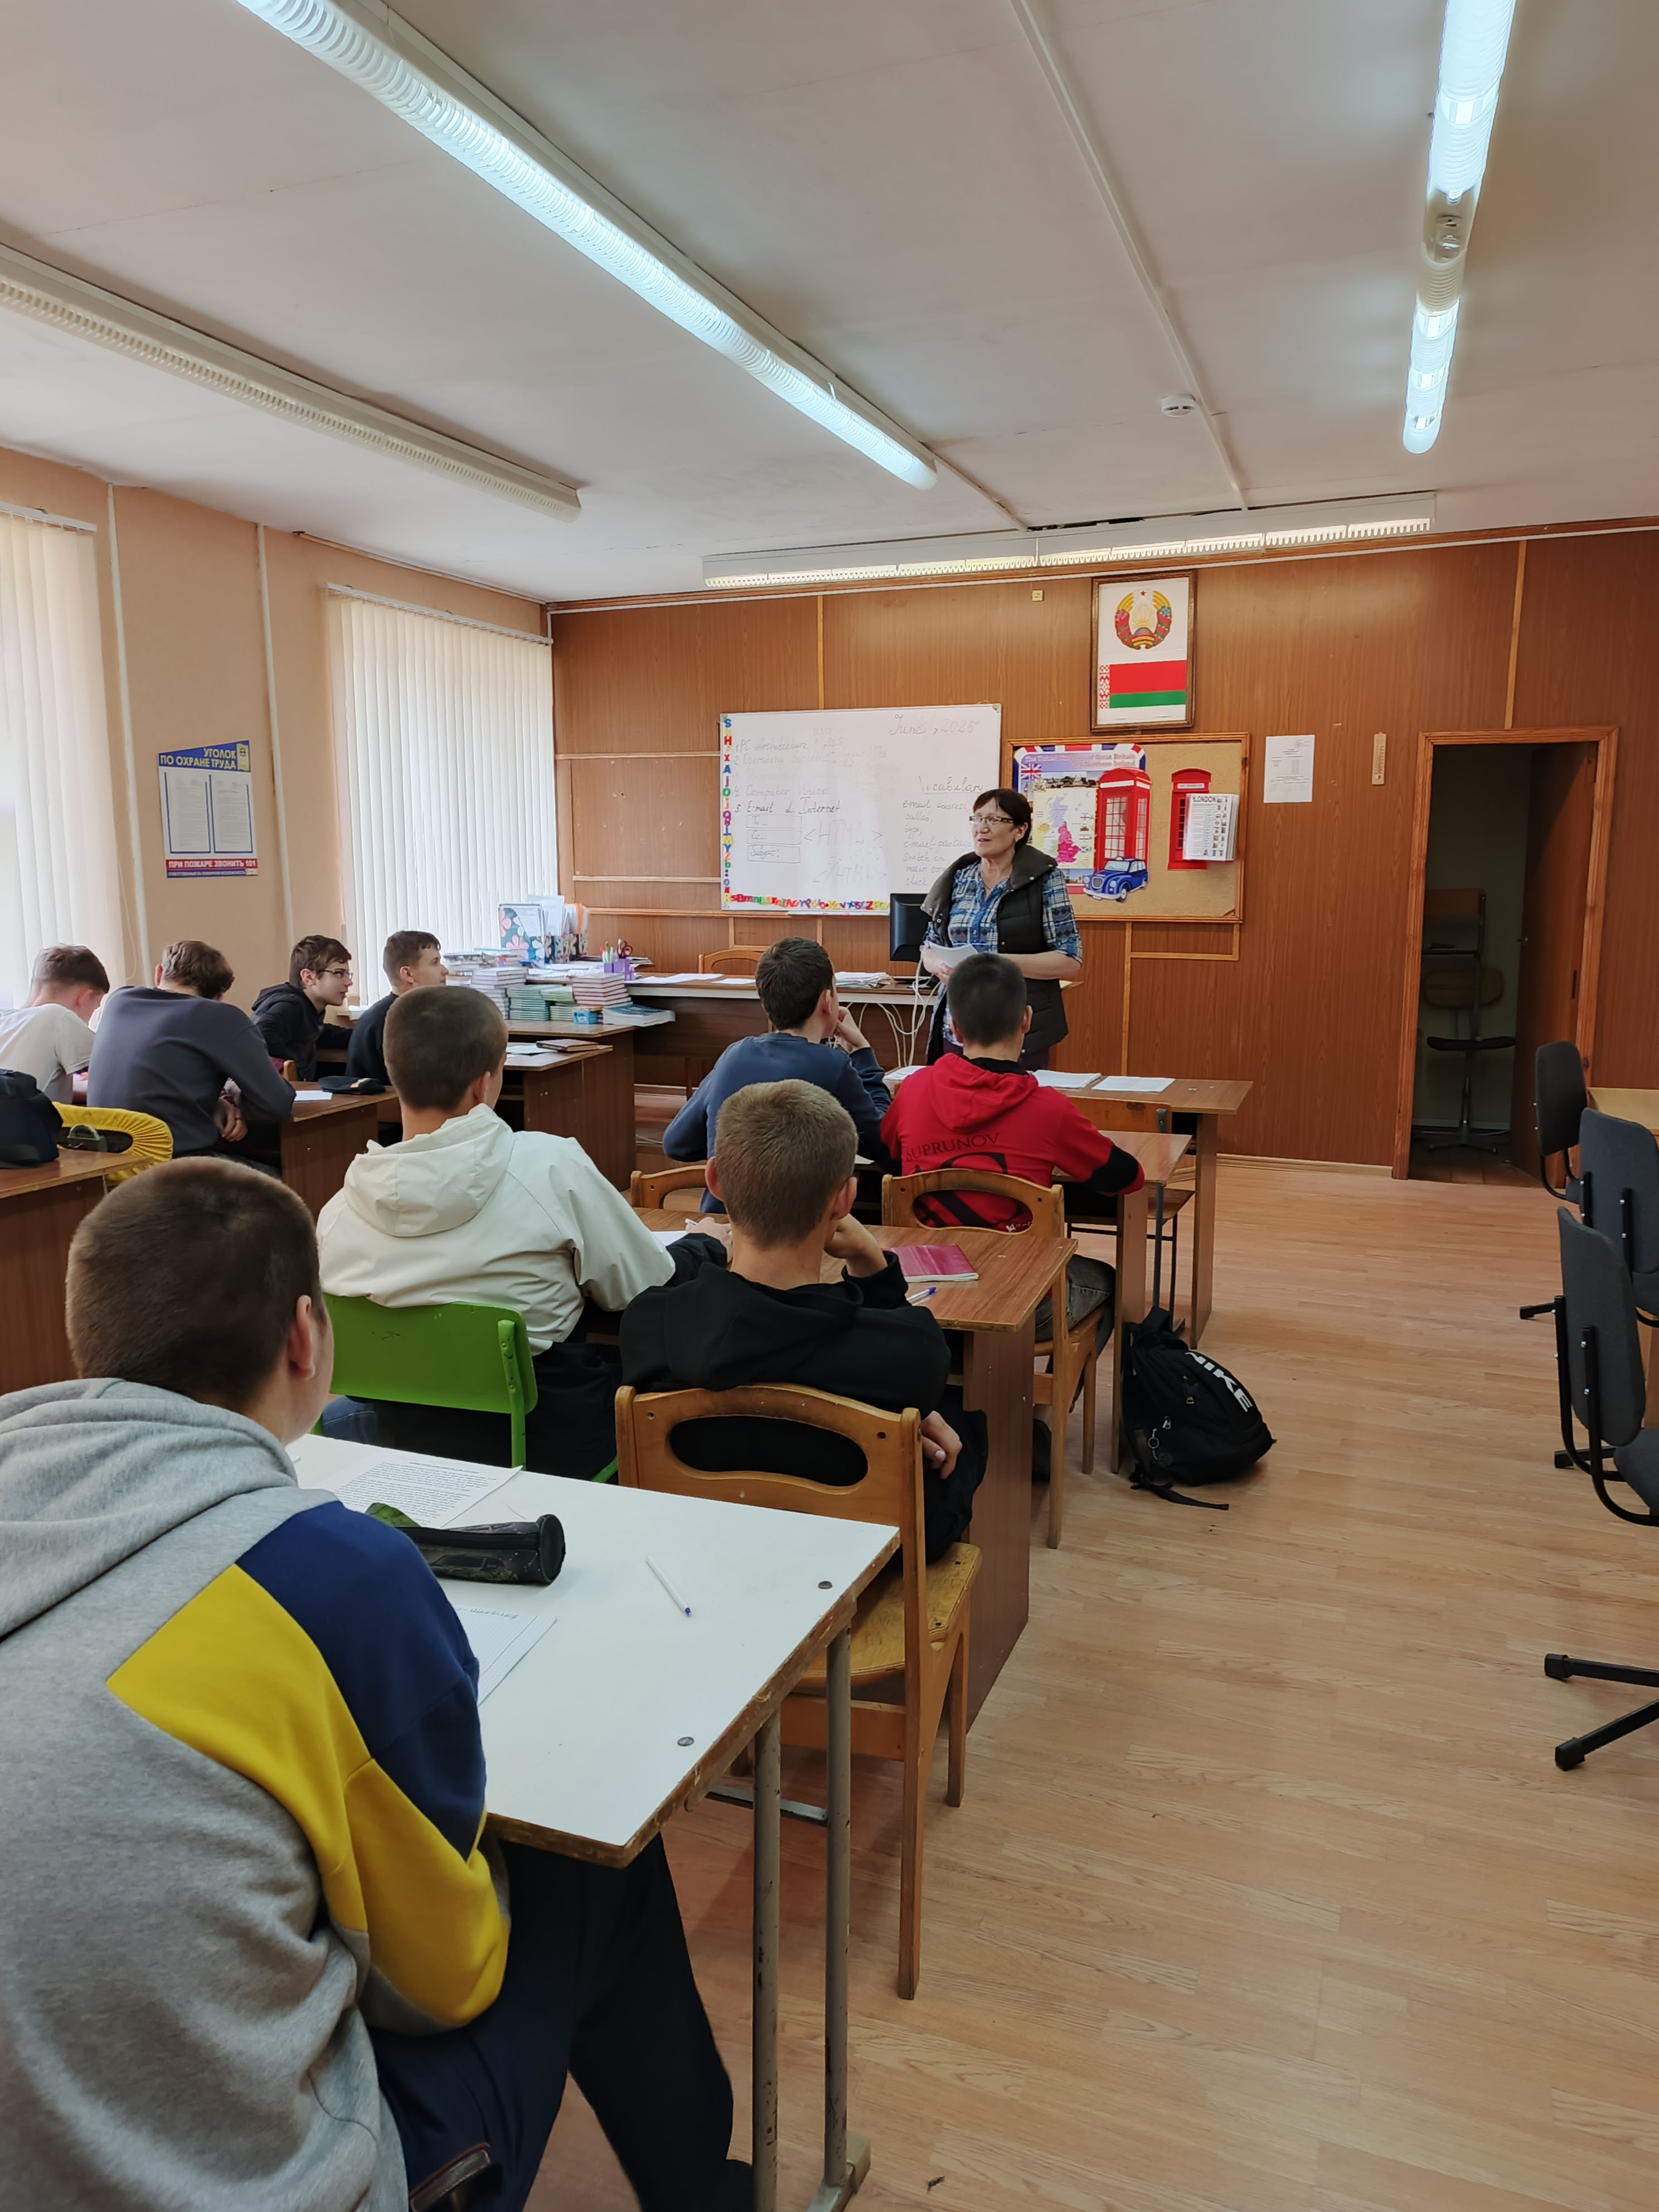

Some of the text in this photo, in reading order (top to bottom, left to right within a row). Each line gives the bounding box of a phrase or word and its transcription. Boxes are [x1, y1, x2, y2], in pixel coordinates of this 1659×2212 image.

[160, 755, 236, 769] ПО ОХРАНЕ ТРУДА
[798, 795, 841, 814] Internet
[906, 1133, 999, 1162] SUPRUNOV
